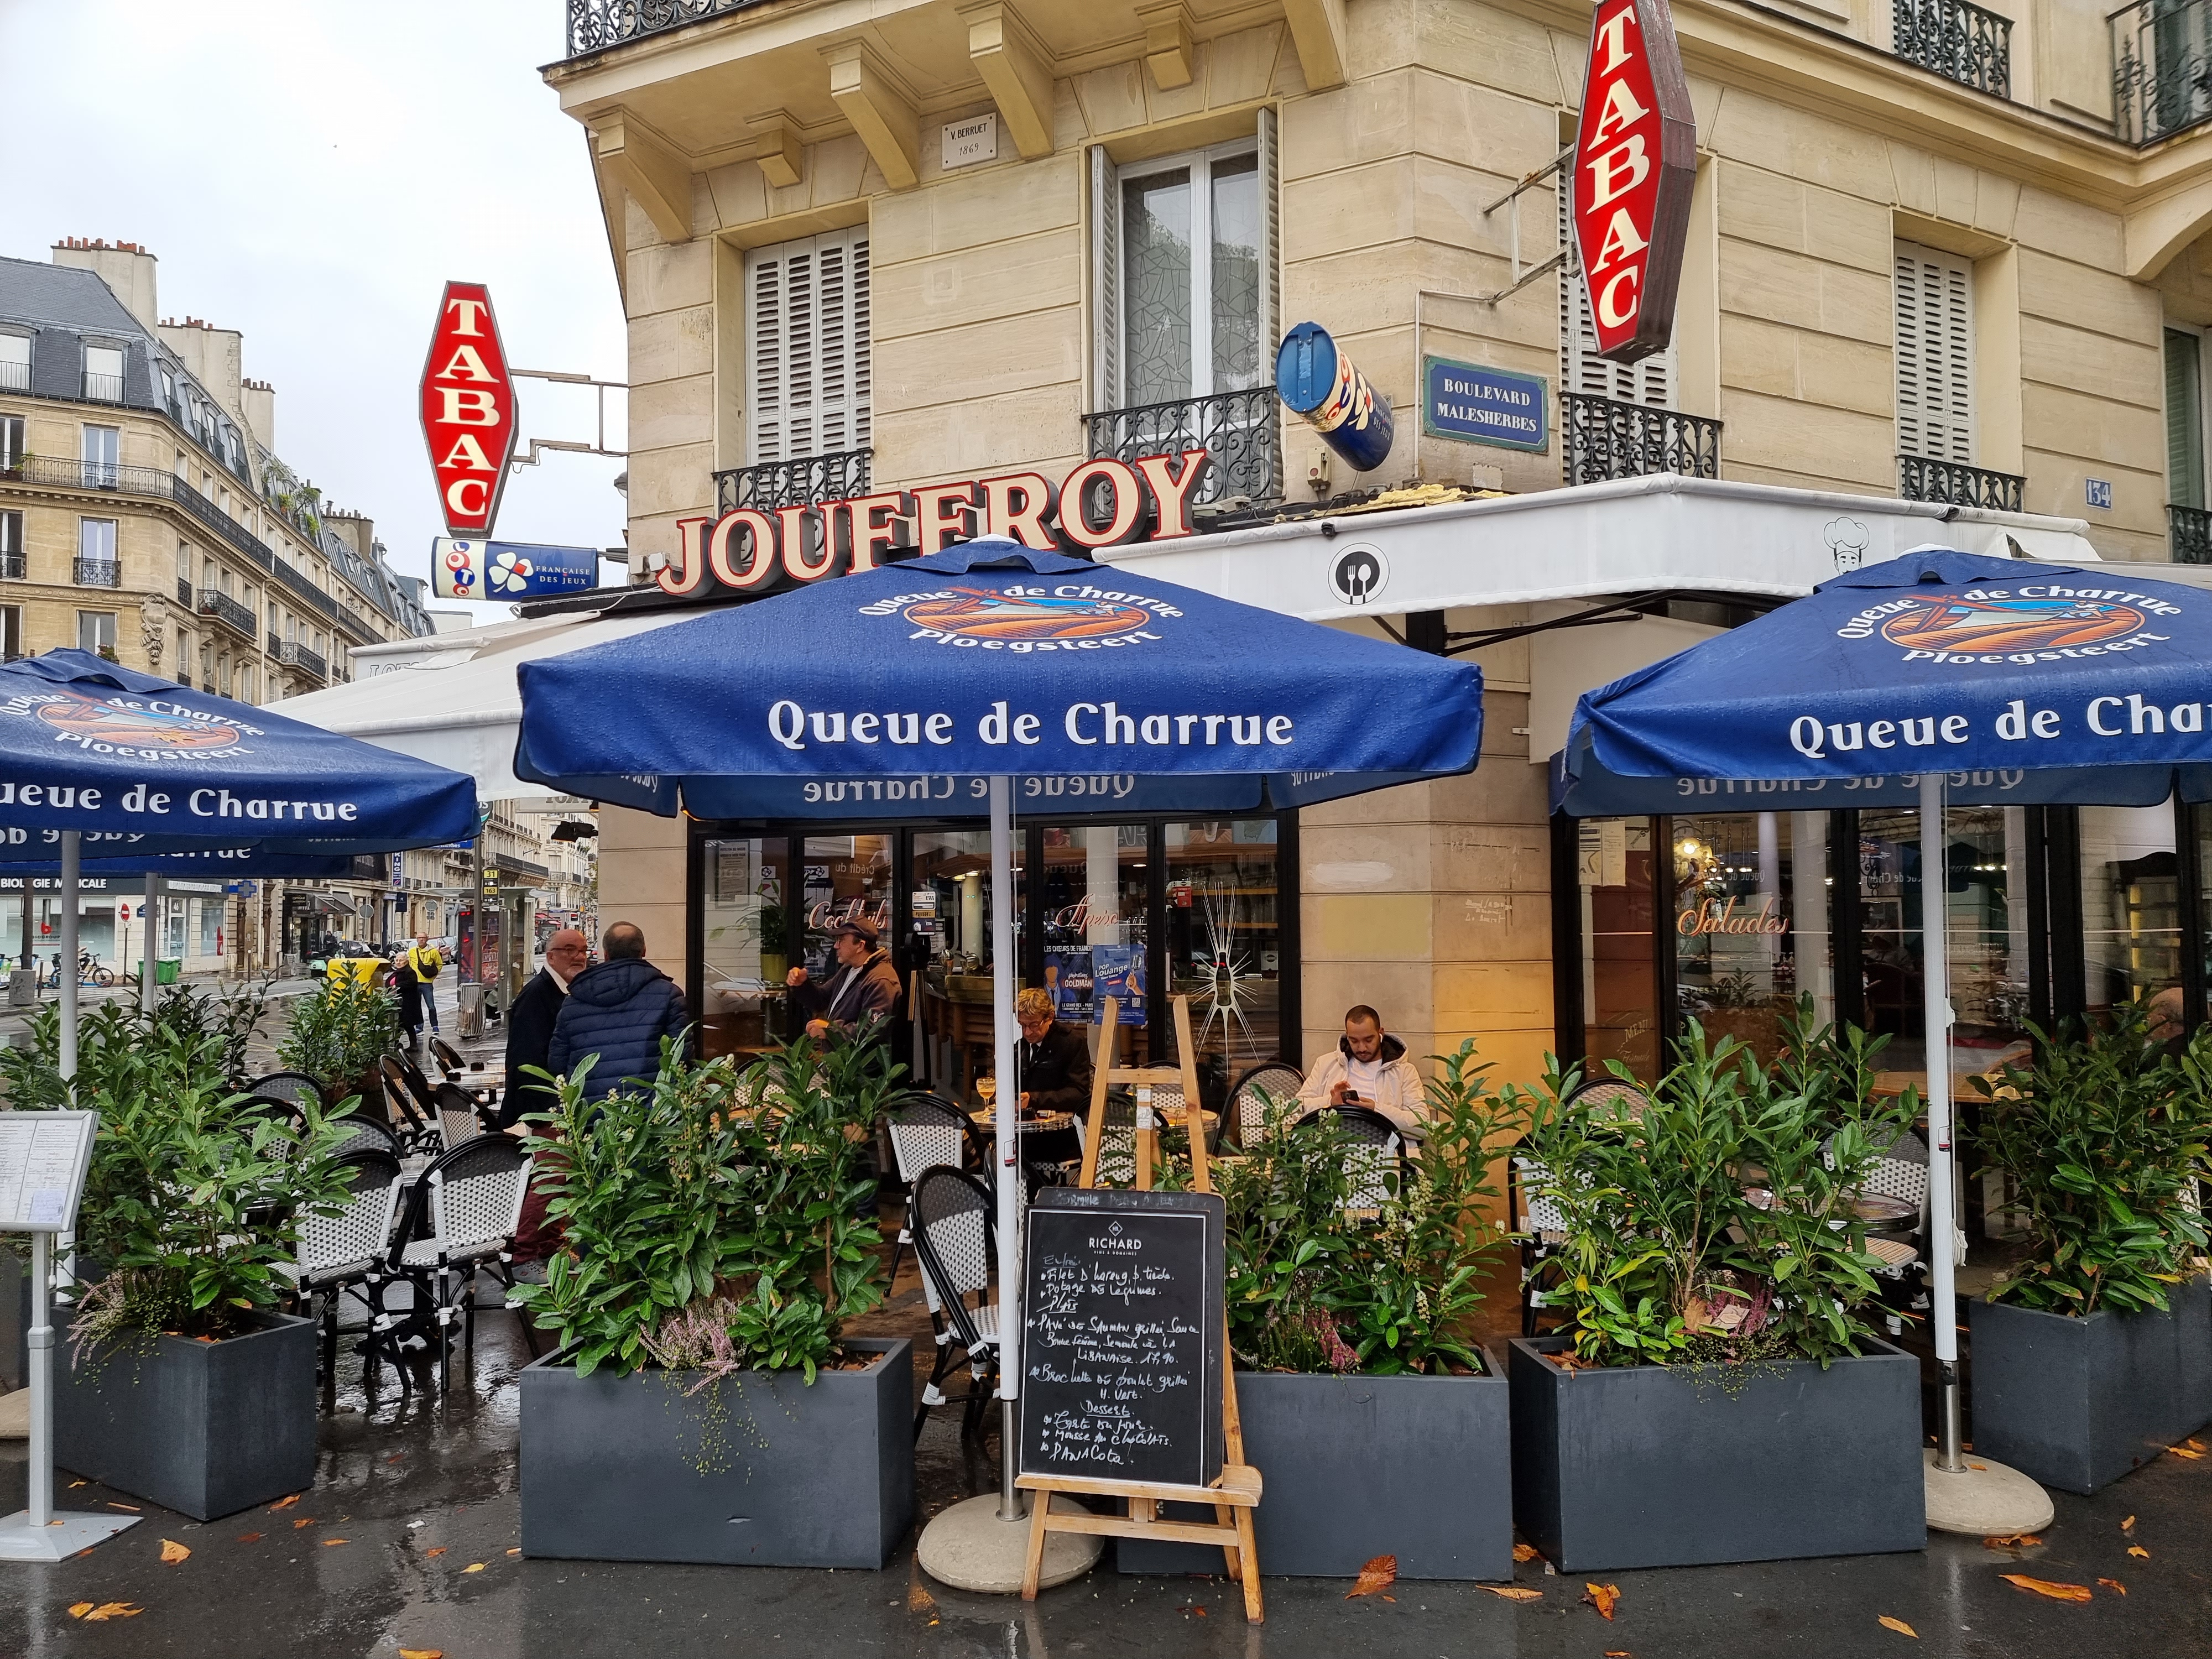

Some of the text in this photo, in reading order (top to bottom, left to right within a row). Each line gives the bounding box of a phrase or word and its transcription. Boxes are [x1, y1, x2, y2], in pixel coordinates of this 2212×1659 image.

[959, 143, 979, 155] 1869
[1585, 4, 1649, 328] TABAC
[434, 299, 500, 515] TABAC
[1444, 378, 1530, 406] BOULEVARD
[1380, 424, 1391, 441] JEUX
[1437, 403, 1537, 432] MALESHERBES
[2088, 481, 2110, 506] 134
[655, 449, 1209, 598] JOUFFROY
[536, 566, 590, 576] FRANÇAISE
[858, 586, 1183, 618] Queue de Charrue
[1837, 585, 2183, 639] Queue de Charrue
[909, 628, 1162, 653] Ploegsteert
[1901, 632, 2171, 665] Ploegsteert
[0, 693, 265, 737] Queue de Charrue
[768, 700, 1293, 750] Queue de Charrue
[1790, 694, 2212, 759] Queue de Cha
[54, 731, 255, 761] Ploegsteert
[0, 782, 357, 821] ueue de Charrue
[1, 878, 107, 889] BIOLGIE MICALE
[1678, 895, 1789, 937] Salades
[1065, 979, 1092, 988] GOLDMAN
[1095, 964, 1128, 977] Louange
[1089, 1237, 1142, 1250] RICHARD
